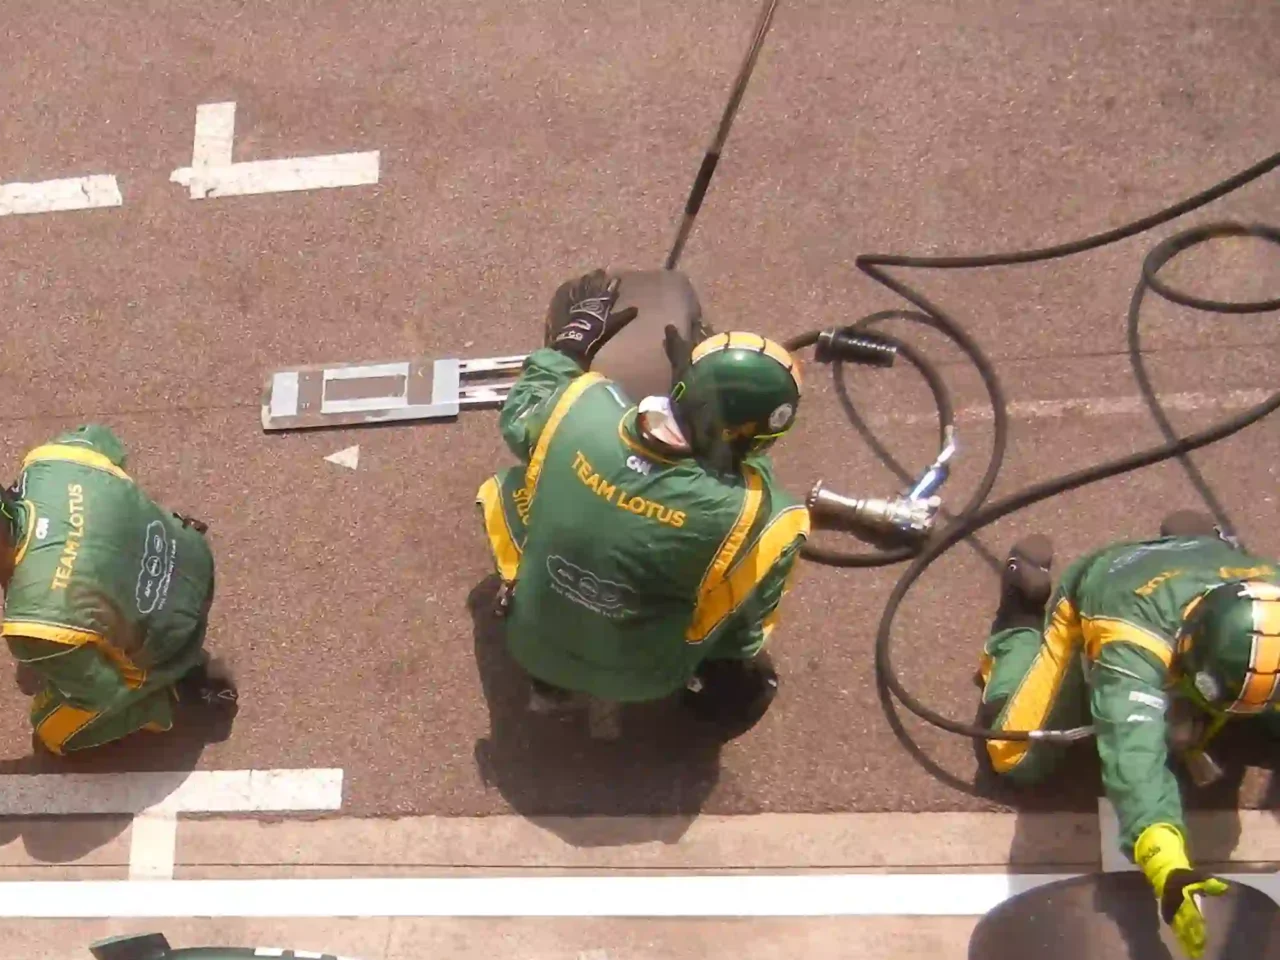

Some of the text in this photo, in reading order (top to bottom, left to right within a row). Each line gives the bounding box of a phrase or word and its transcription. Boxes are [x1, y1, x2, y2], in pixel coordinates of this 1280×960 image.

[571, 450, 686, 527] TEAM LOTUS
[50, 483, 84, 590] TEAM LOTUS
